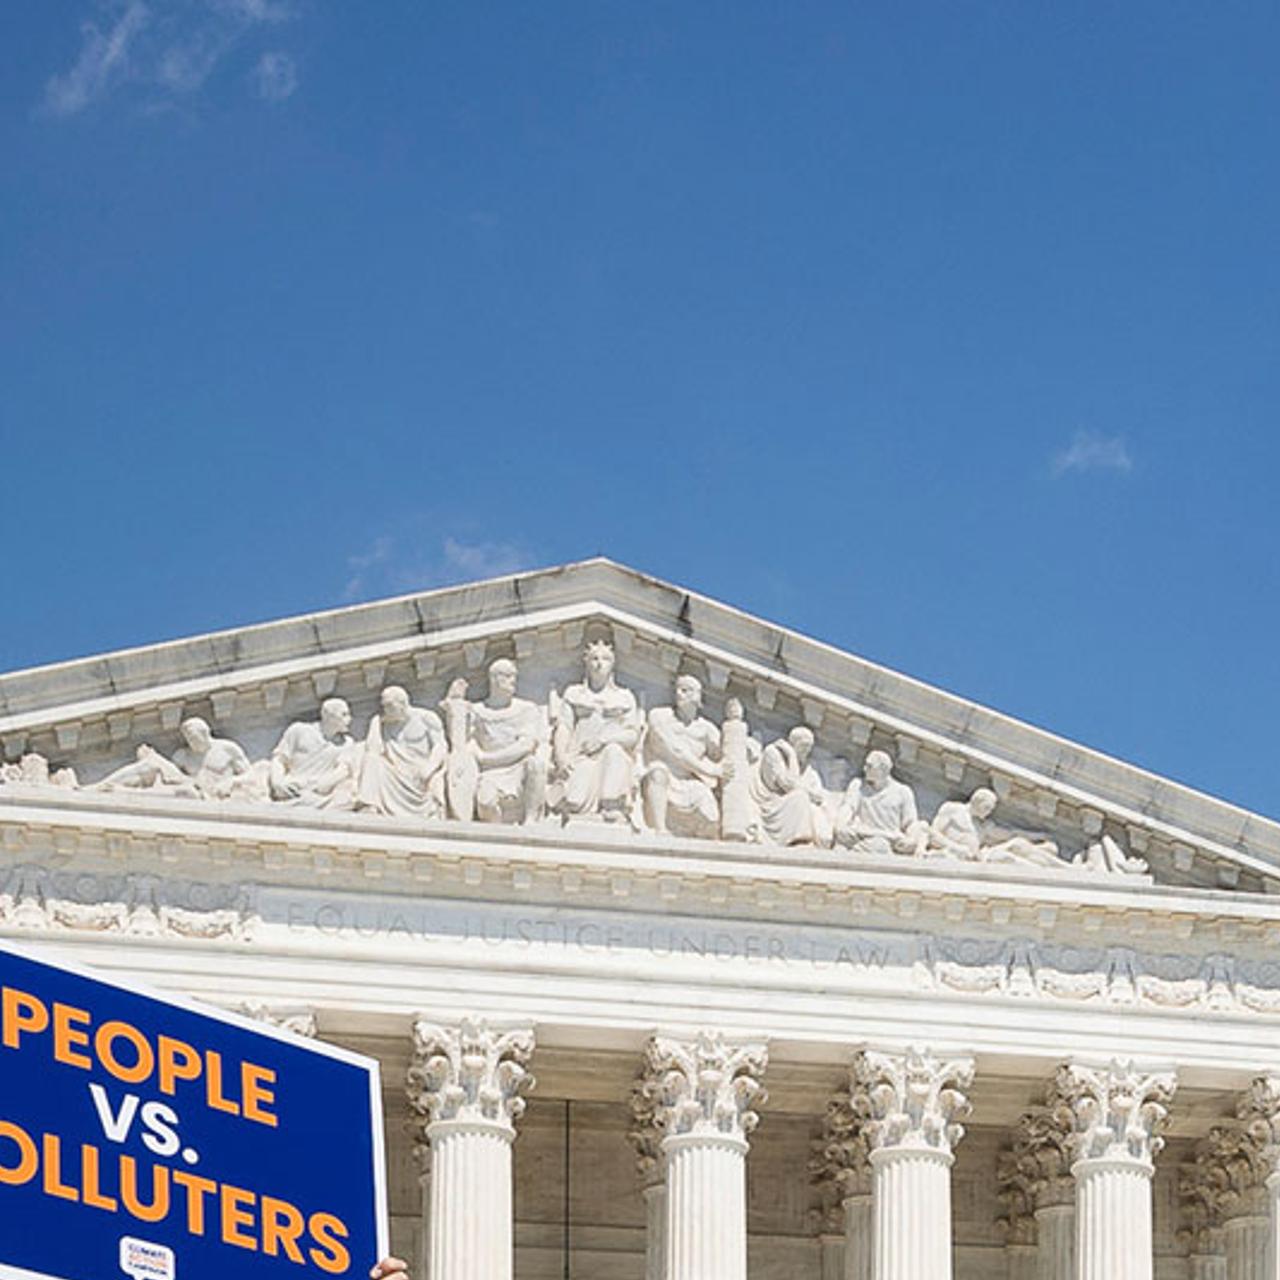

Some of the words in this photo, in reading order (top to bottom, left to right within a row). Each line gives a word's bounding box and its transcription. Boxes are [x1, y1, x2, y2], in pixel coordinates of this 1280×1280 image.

[287, 902, 438, 942] EQUAL
[455, 917, 623, 953] JUSTICE
[648, 929, 788, 963] UNDER
[808, 939, 892, 970] LAW
[2, 986, 279, 1127] PEOPLE
[88, 1082, 199, 1165] VS.
